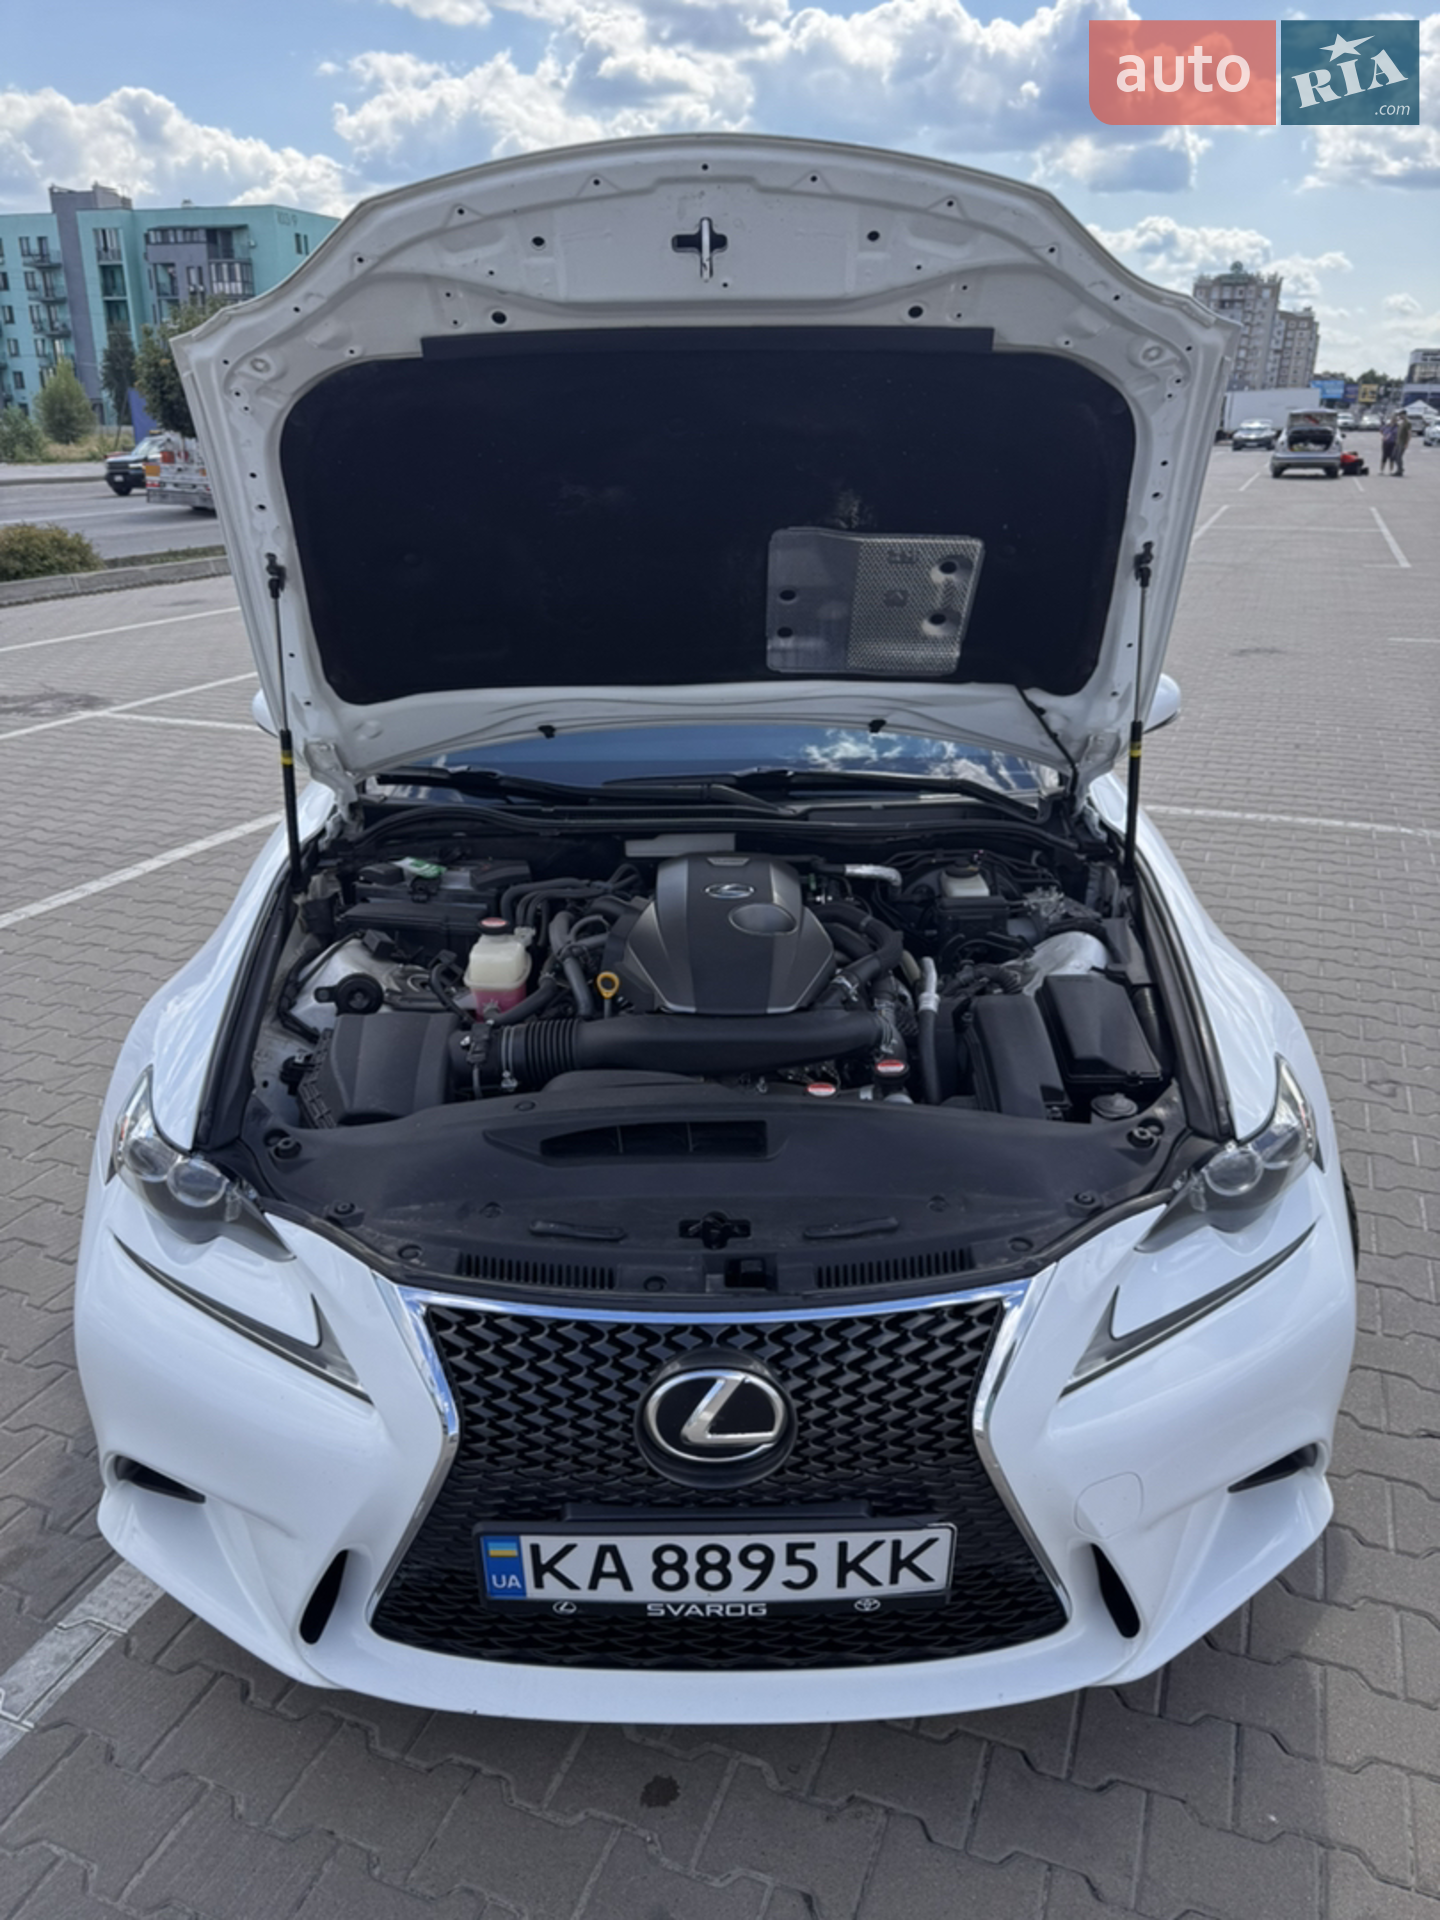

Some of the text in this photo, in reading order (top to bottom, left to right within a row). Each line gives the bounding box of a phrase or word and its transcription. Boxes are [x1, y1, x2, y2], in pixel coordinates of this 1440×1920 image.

[529, 1537, 941, 1592] KA 8895 KK
[491, 1574, 522, 1589] UA
[646, 1603, 768, 1617] SVAROG
